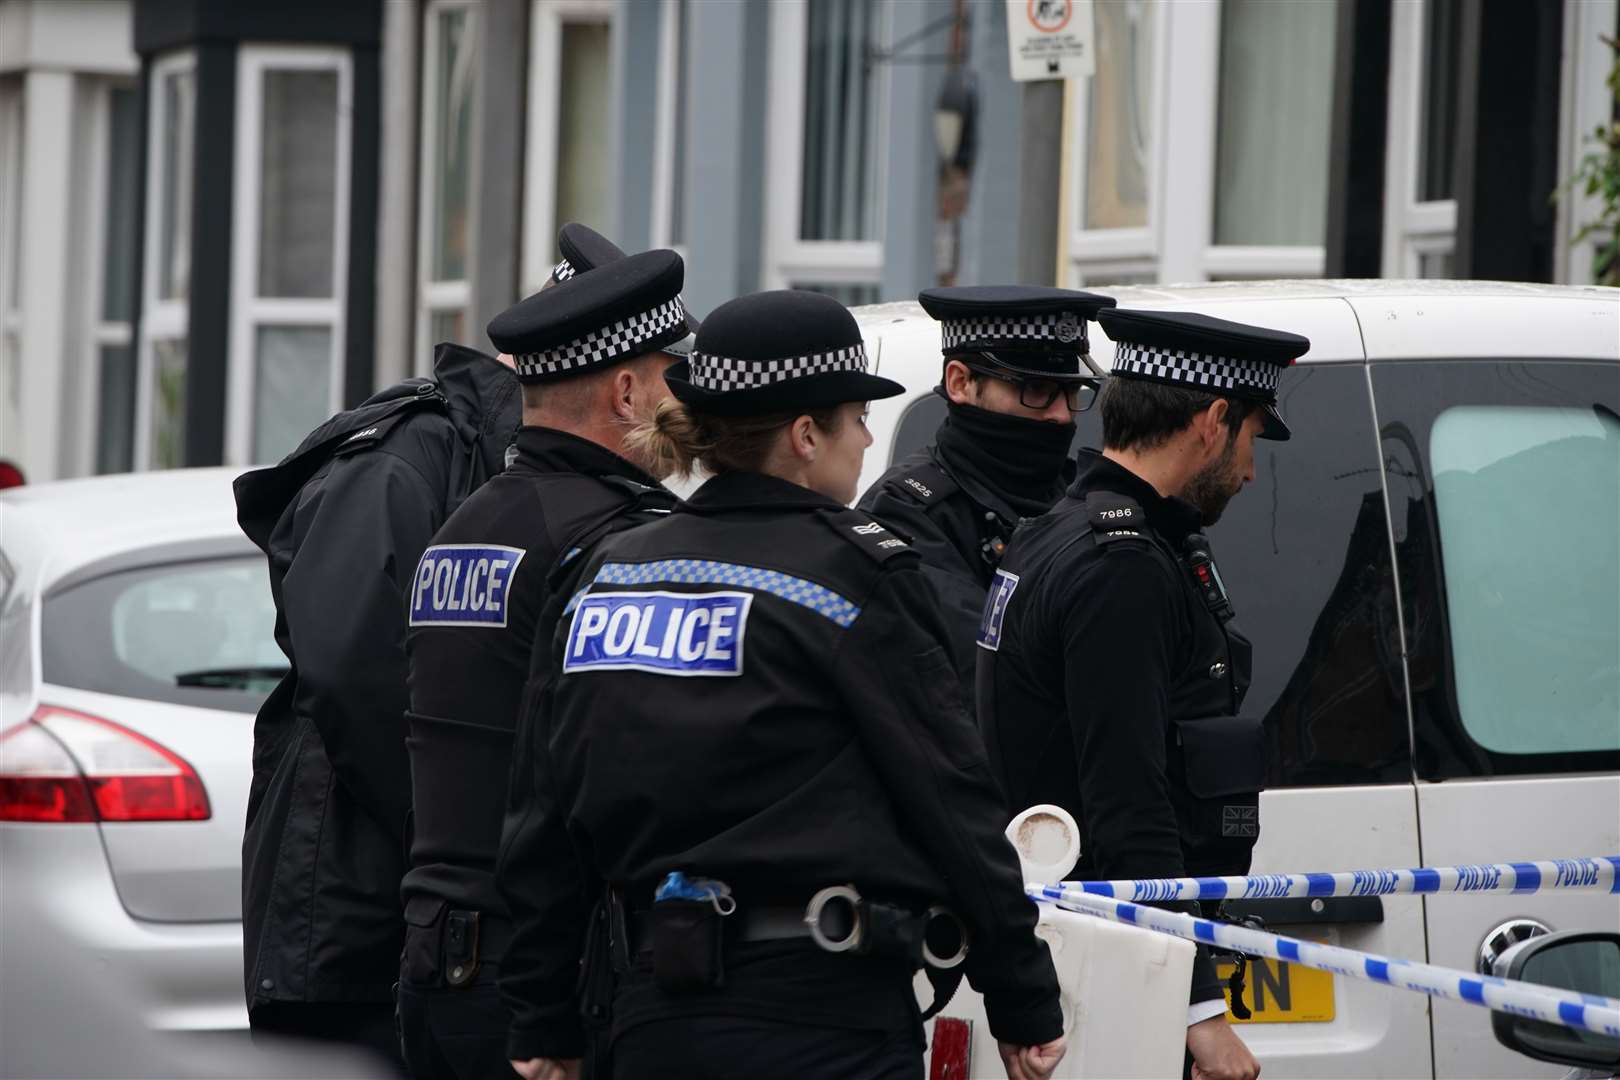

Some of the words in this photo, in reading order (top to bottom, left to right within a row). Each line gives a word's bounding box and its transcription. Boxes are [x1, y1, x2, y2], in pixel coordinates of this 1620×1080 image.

[1099, 508, 1132, 519] 7986
[415, 558, 510, 611] POLICE
[573, 604, 737, 662] POLICE
[1133, 878, 1184, 900] POLICE
[1243, 874, 1294, 898] POLICE
[1351, 868, 1400, 896] POLICE
[1455, 864, 1502, 892] POLICE
[1553, 857, 1600, 887] POLICE
